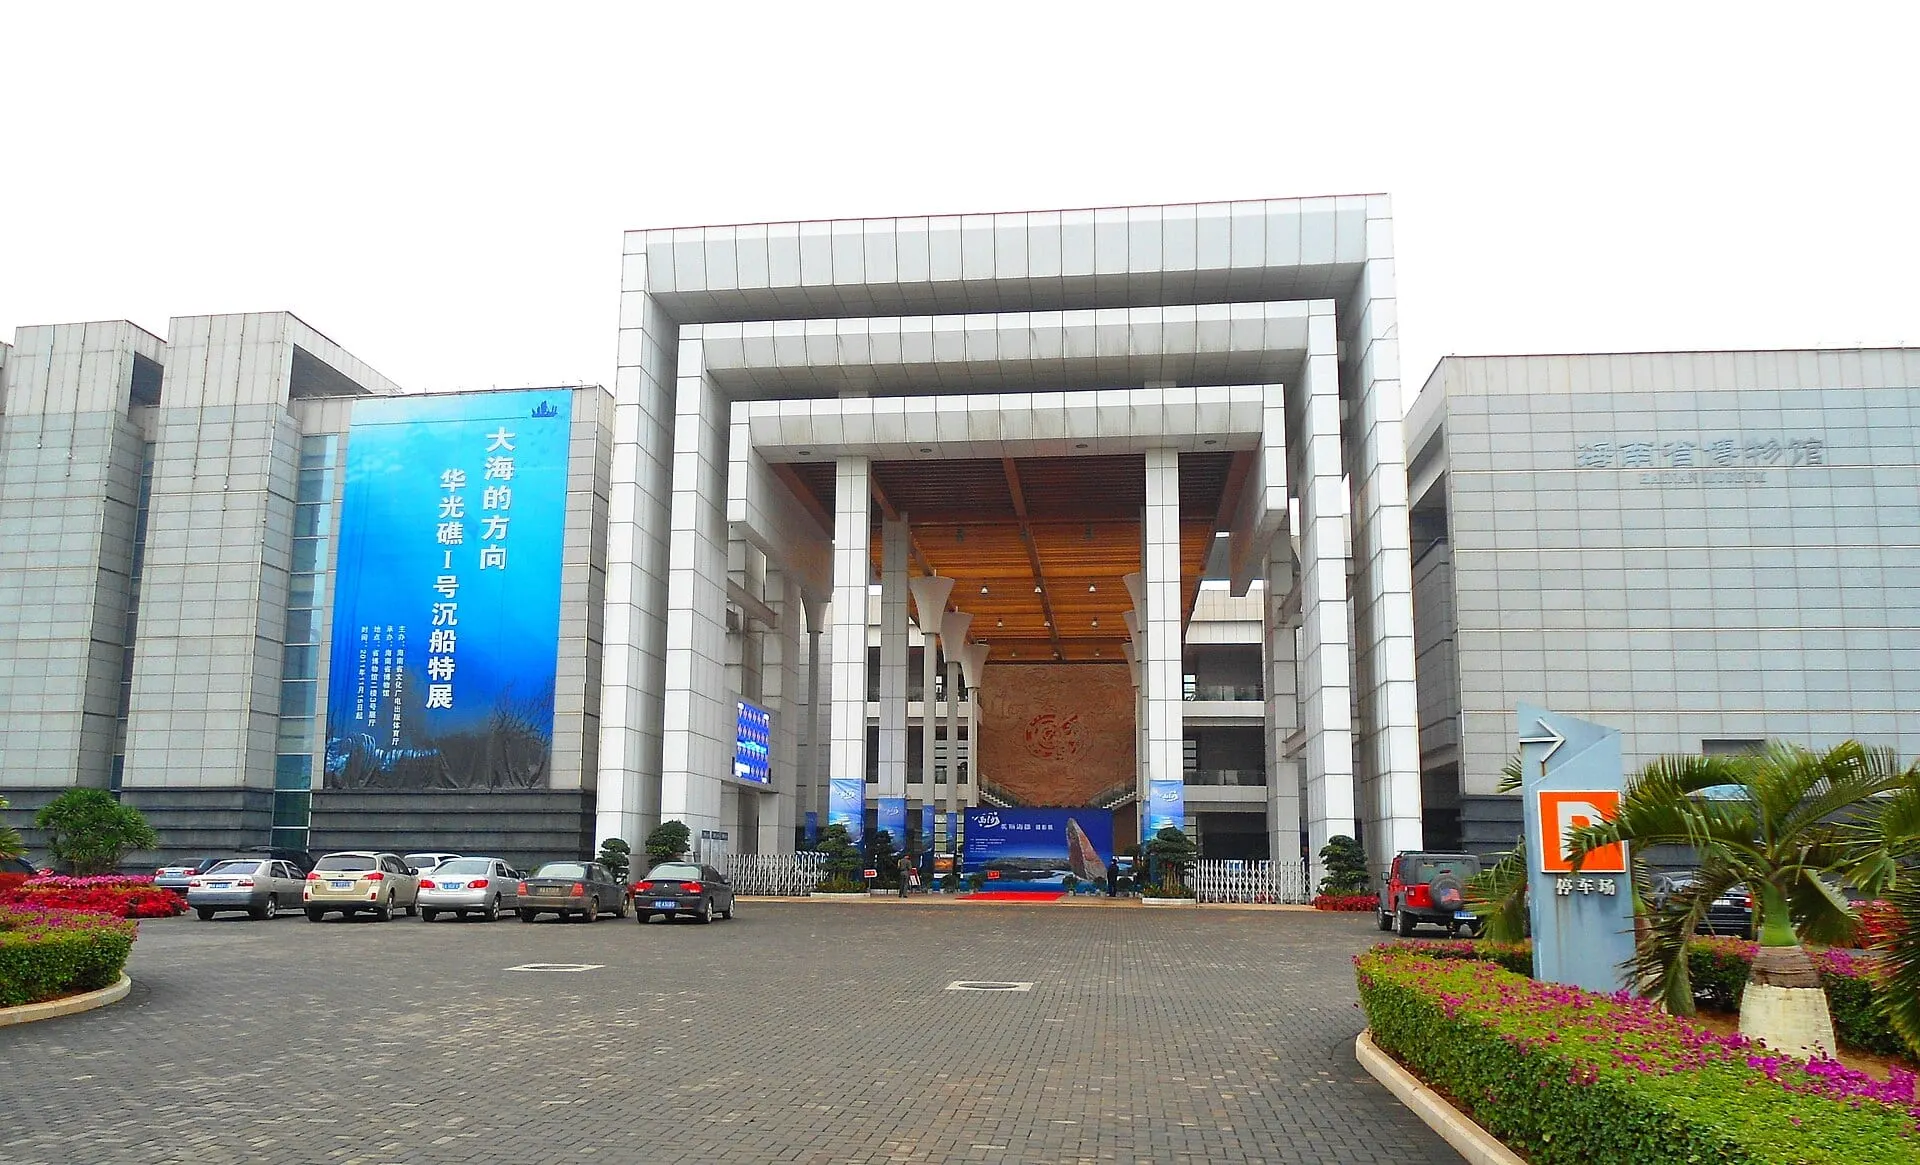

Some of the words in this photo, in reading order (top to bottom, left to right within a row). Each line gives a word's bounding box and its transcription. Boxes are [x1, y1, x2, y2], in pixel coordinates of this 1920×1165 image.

[479, 426, 516, 571] 大海的方向
[1557, 801, 1609, 862] P
[1556, 878, 1616, 896] 停车场
